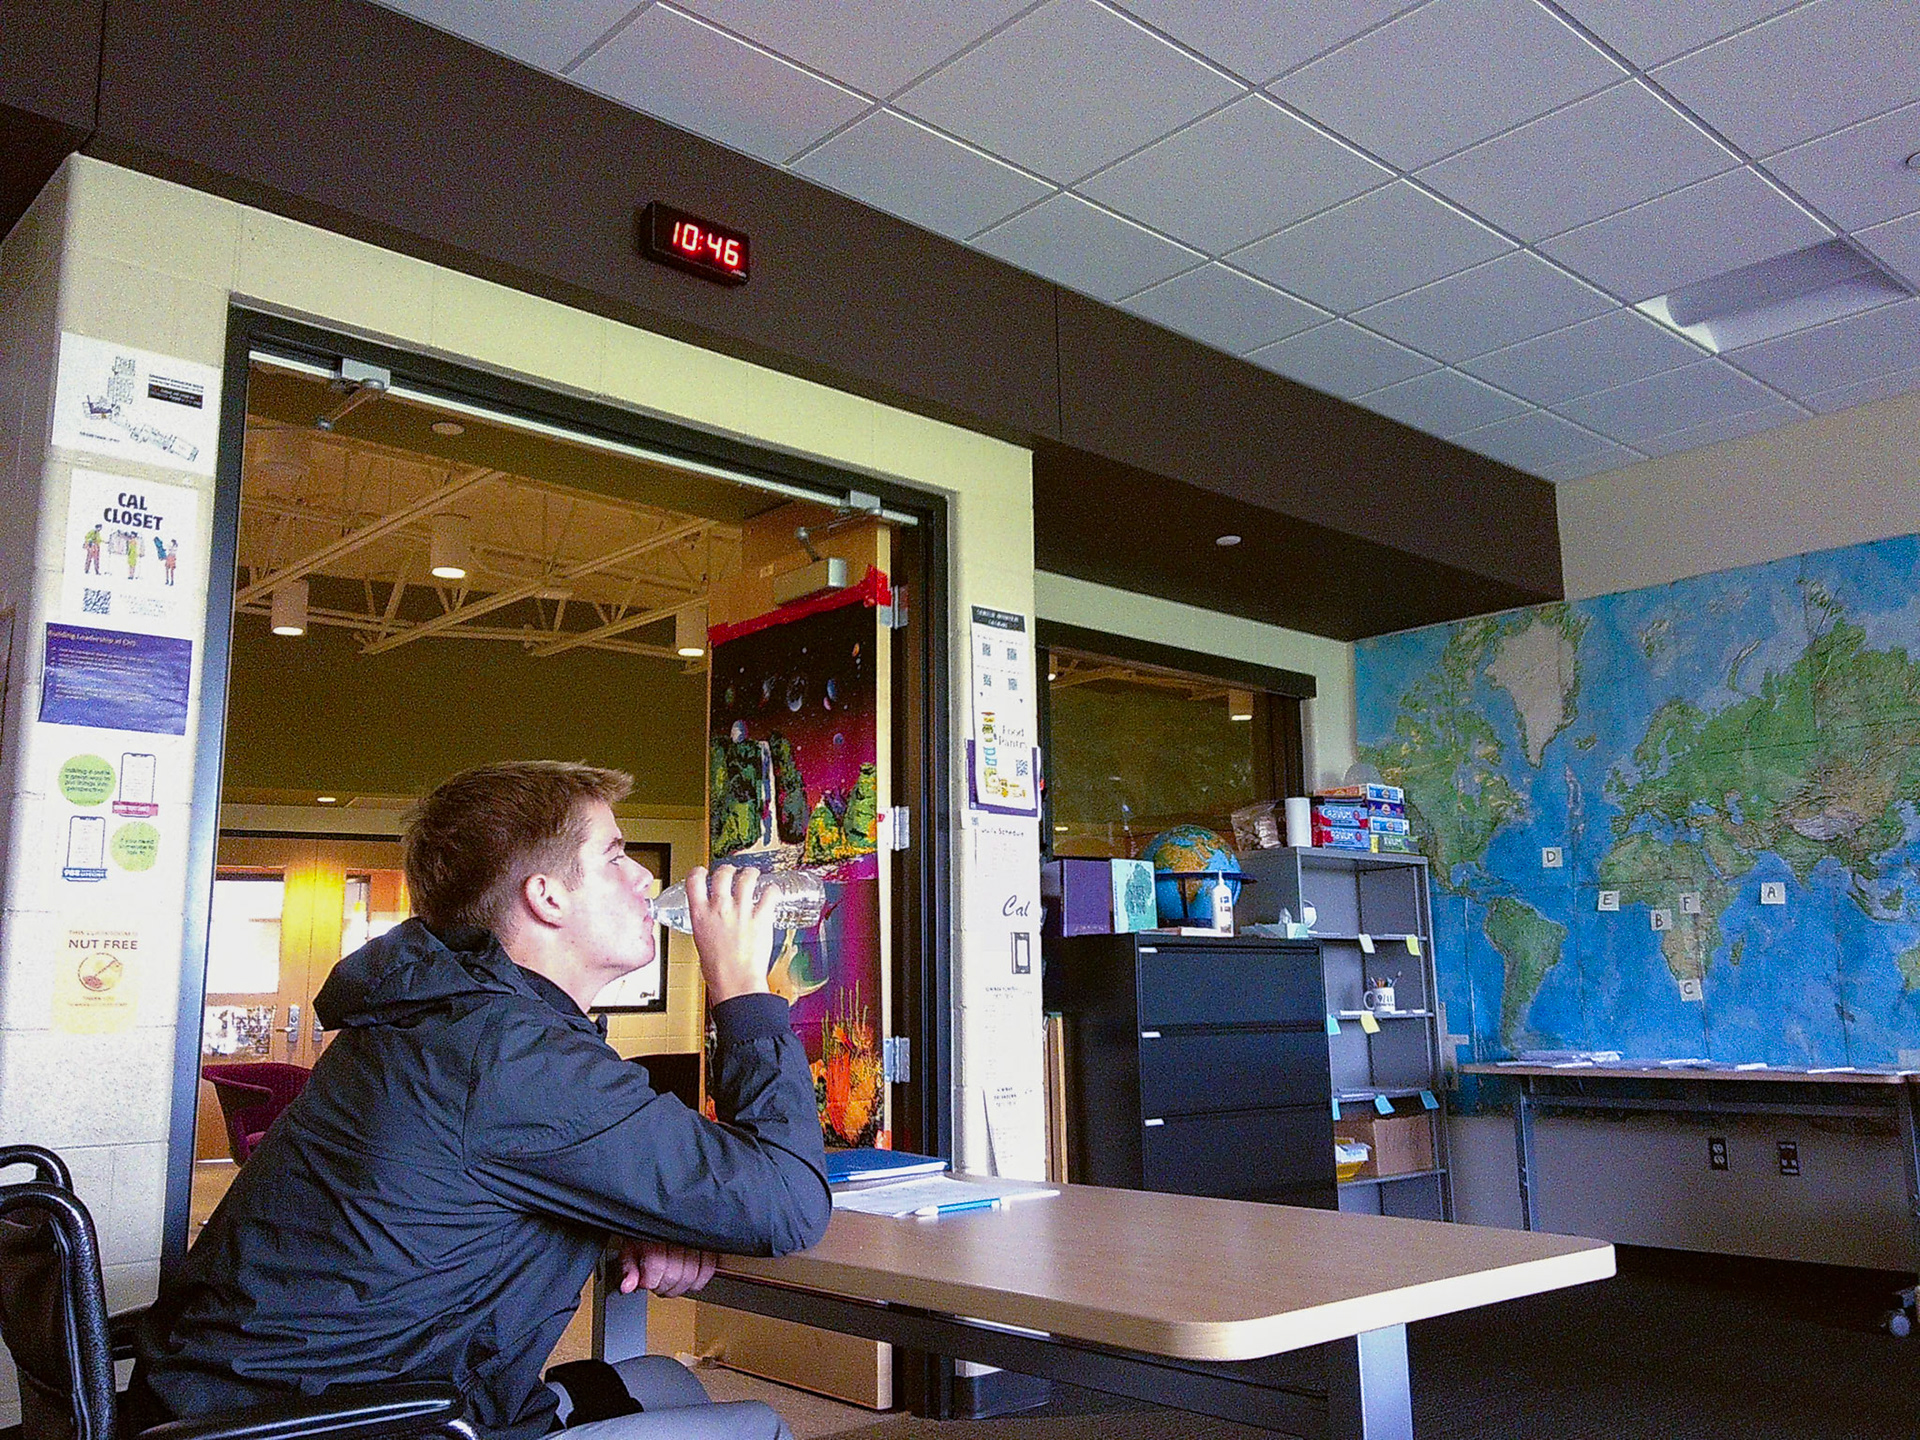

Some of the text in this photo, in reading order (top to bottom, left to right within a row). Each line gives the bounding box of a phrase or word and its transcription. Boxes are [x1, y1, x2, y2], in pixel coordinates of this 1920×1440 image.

[672, 221, 740, 267] 10:46
[117, 492, 149, 511] CAL
[103, 507, 164, 531] CLOSET
[1546, 851, 1556, 863] D
[1603, 893, 1612, 906] E
[1767, 886, 1777, 899] A
[1002, 894, 1031, 917] Cal
[1683, 896, 1692, 911] F
[1655, 913, 1664, 927] B
[68, 939, 138, 950] NUT FREE
[1684, 982, 1694, 996] C
